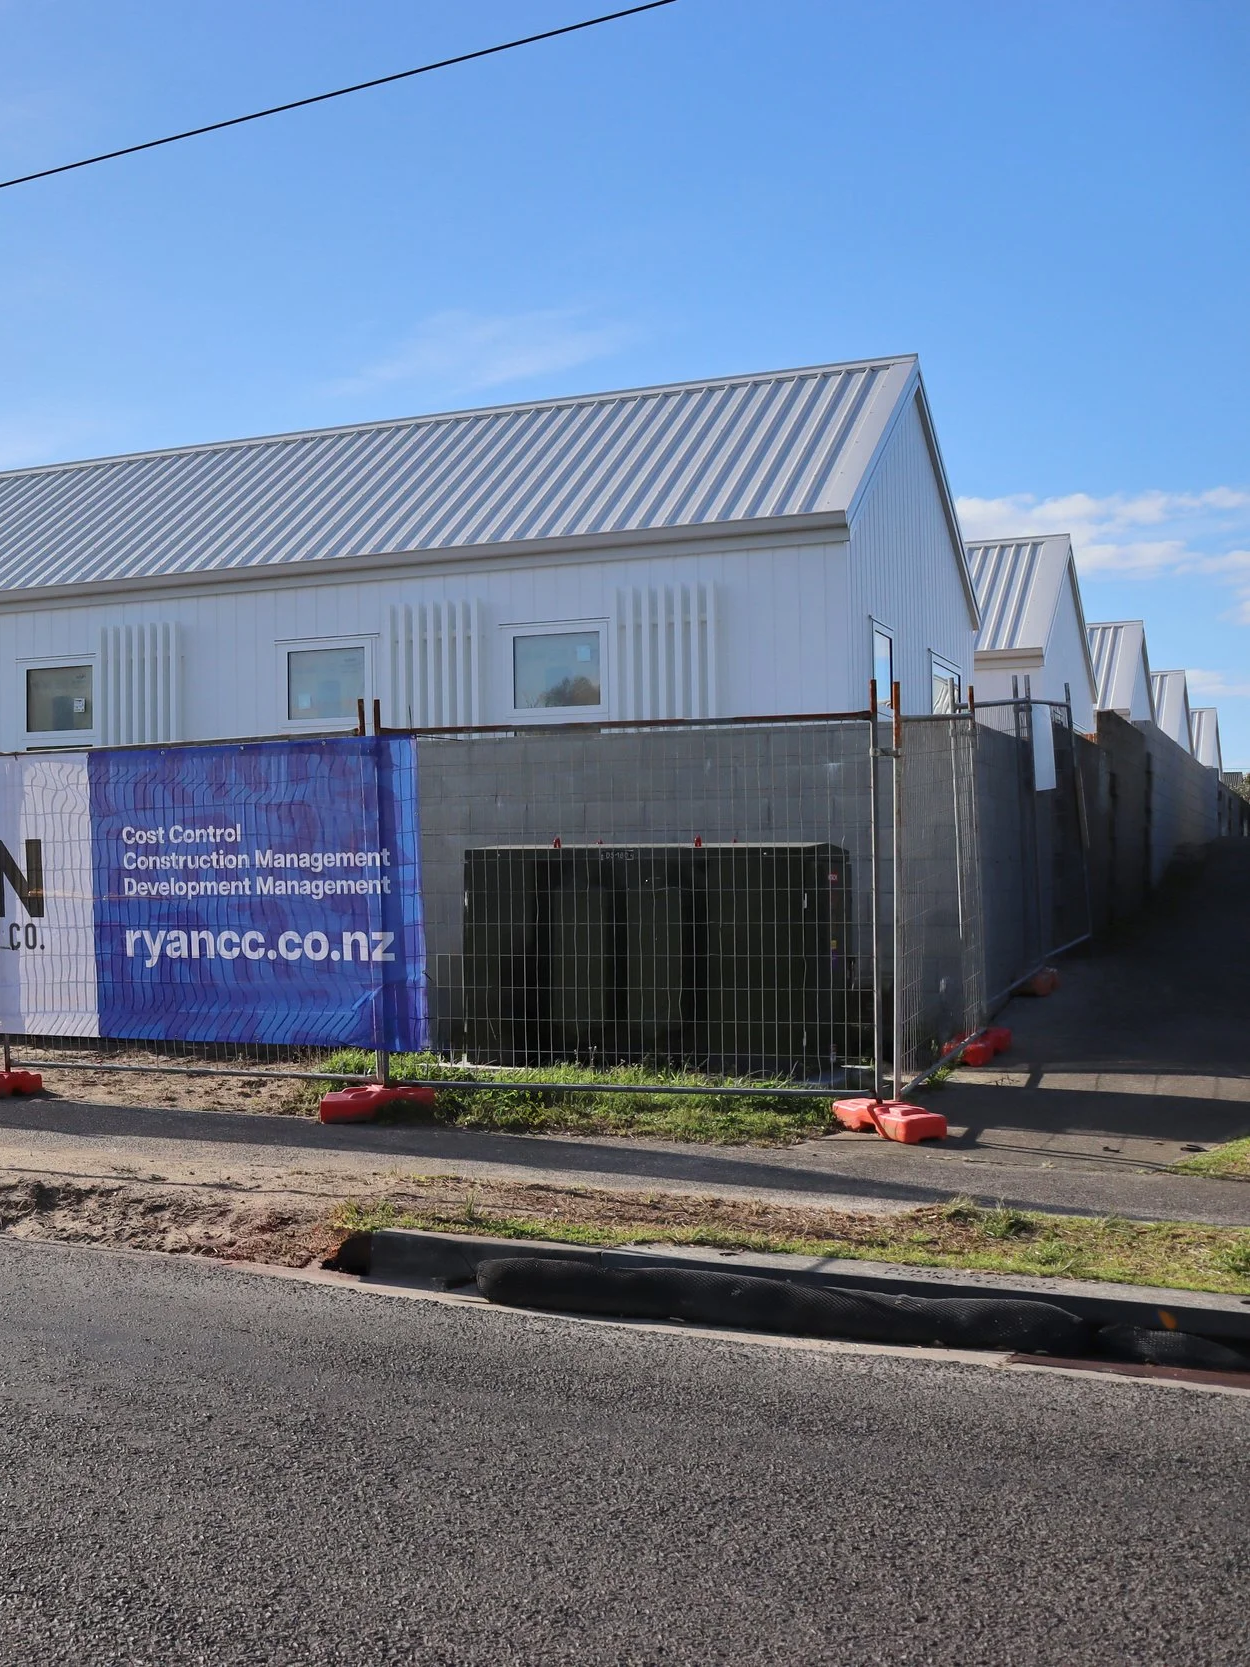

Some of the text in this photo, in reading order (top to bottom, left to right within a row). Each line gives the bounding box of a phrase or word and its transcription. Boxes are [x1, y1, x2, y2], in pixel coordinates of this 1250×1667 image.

[122, 824, 241, 844] Cost Control
[123, 848, 391, 872] Construction Management
[124, 875, 391, 899] Development Management
[9, 923, 45, 950] CO.
[125, 929, 396, 968] ryancc.co.nz
